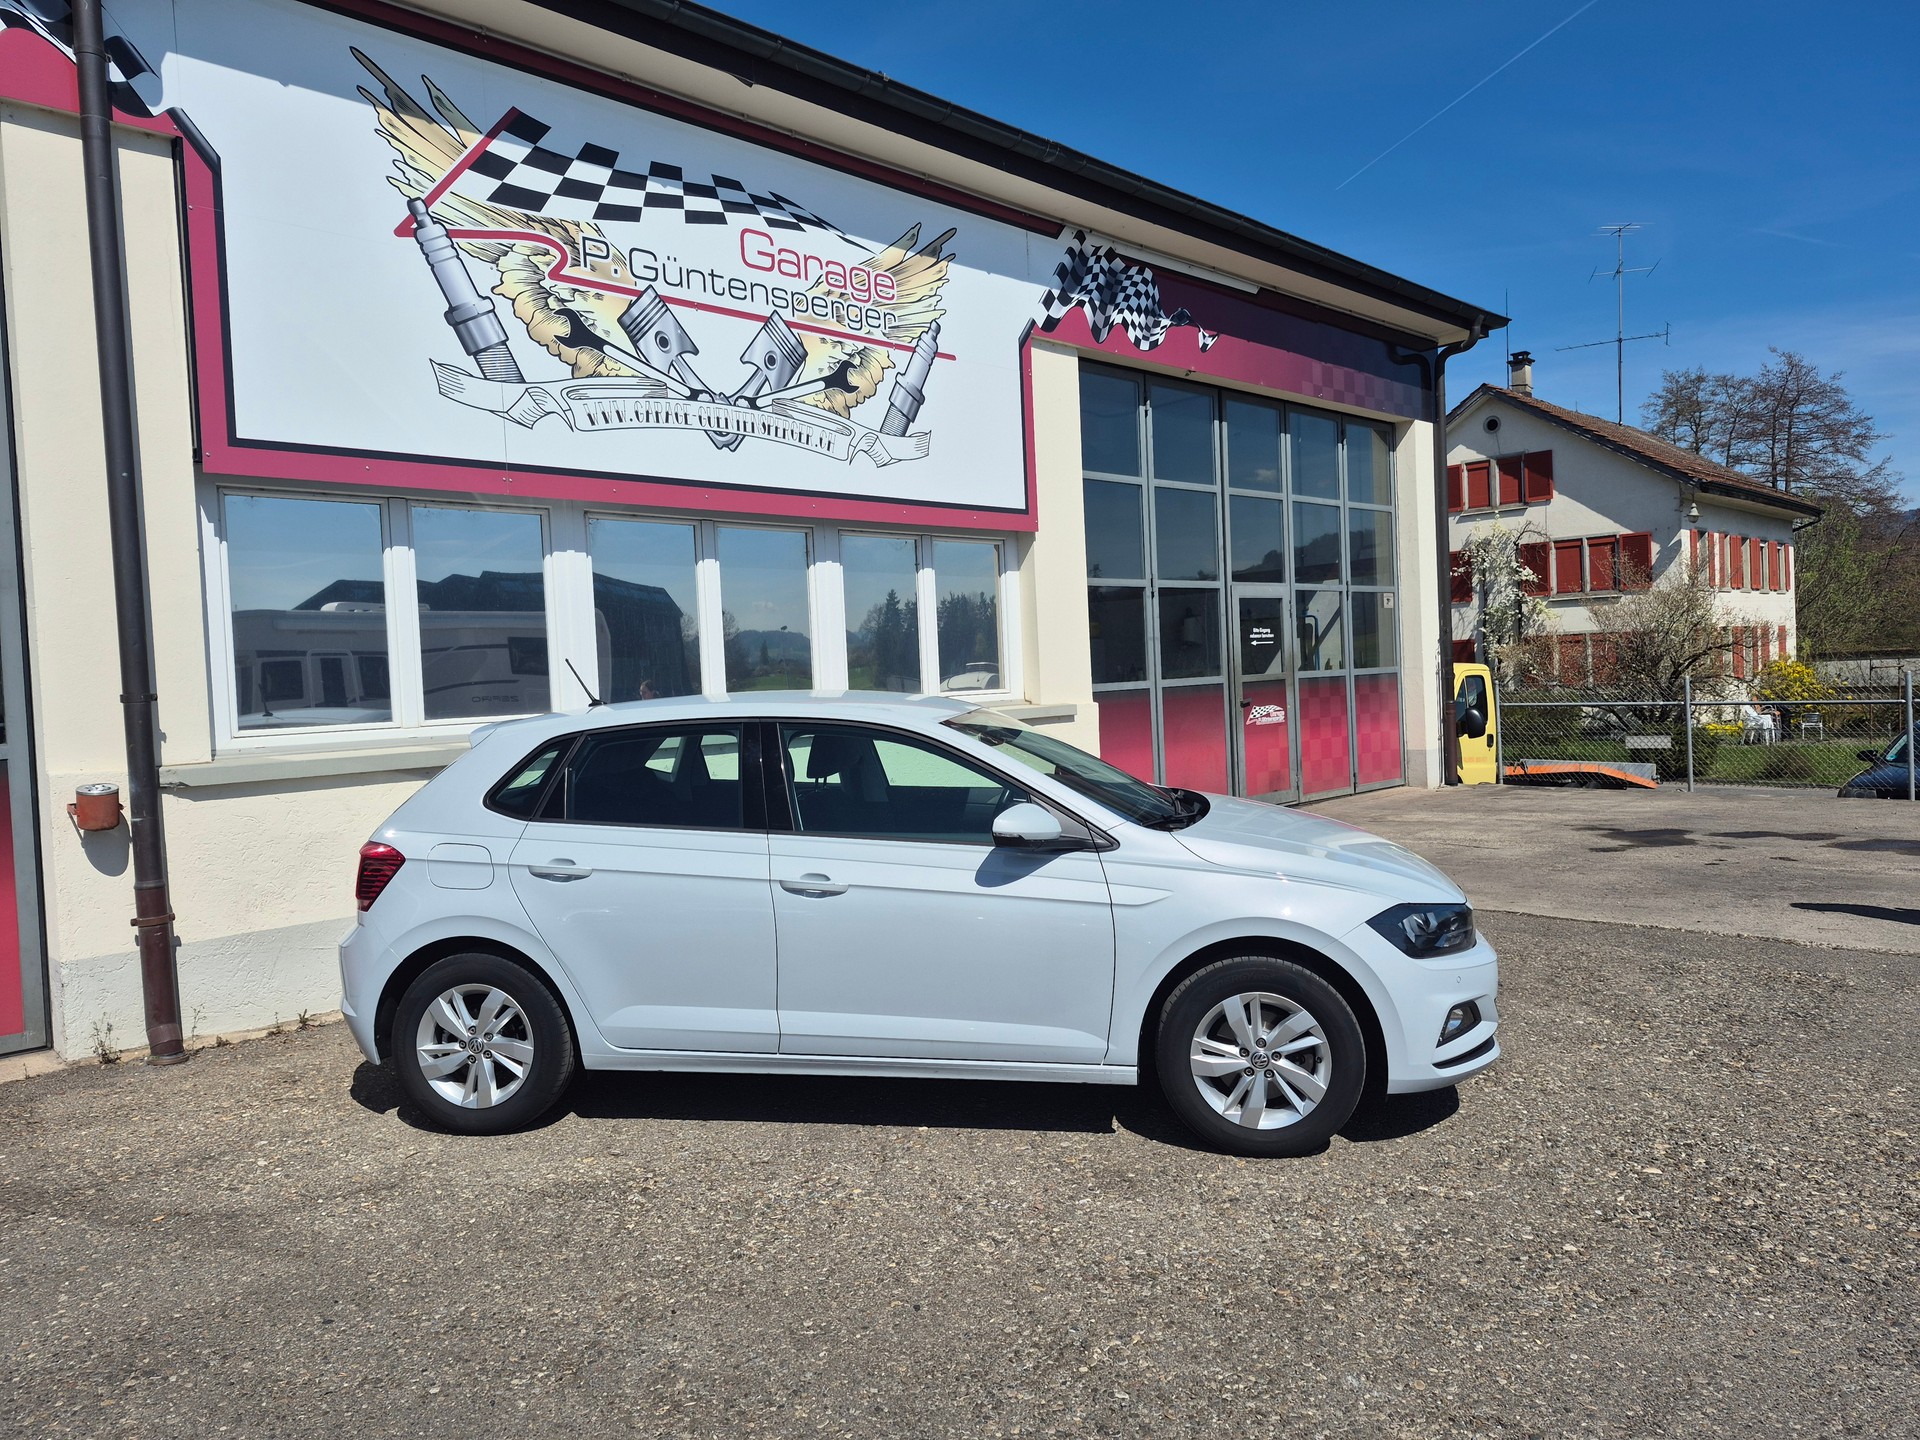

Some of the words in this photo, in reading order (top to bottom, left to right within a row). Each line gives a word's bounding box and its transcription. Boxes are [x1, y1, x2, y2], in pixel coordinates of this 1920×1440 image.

[582, 236, 618, 275] P.
[629, 247, 897, 331] Güntensperger
[740, 228, 895, 303] Garage
[583, 400, 837, 454] WWW.GARAGE-GUENTENSPERGER.CH
